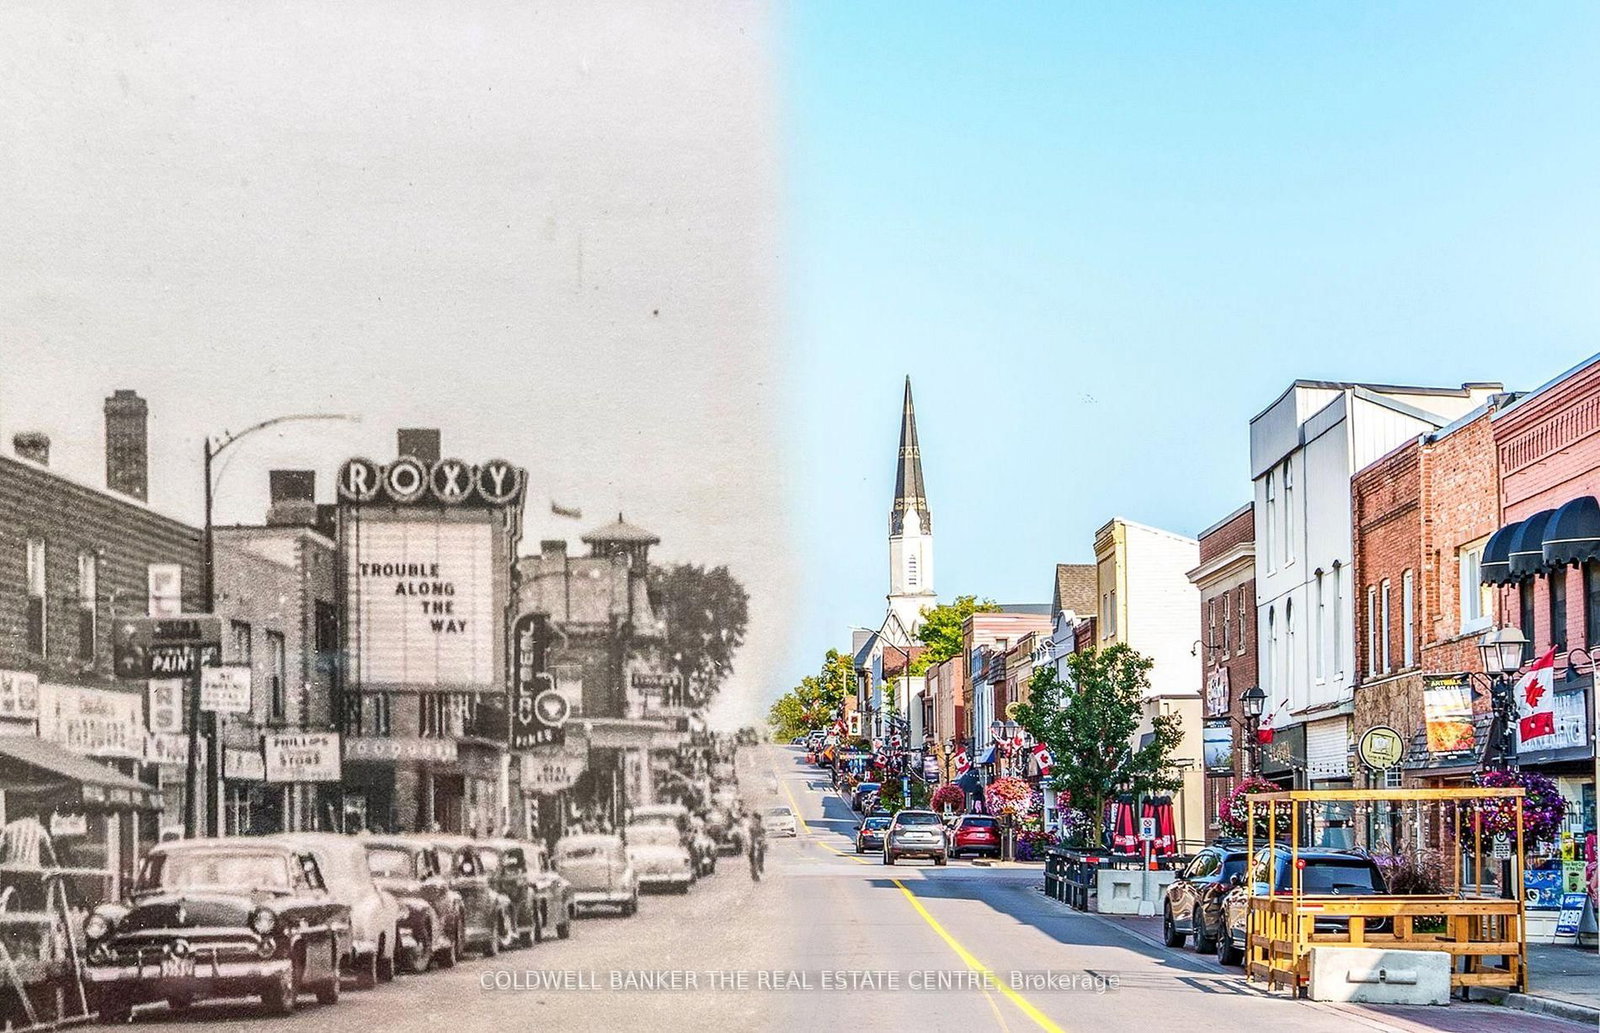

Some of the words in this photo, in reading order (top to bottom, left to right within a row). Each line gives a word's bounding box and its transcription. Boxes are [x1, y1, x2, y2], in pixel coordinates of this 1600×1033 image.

[350, 462, 507, 495] ROXY
[360, 563, 439, 578] TROUBLE
[395, 582, 455, 596] ALONG
[421, 601, 454, 614] THE
[430, 620, 467, 633] WAY
